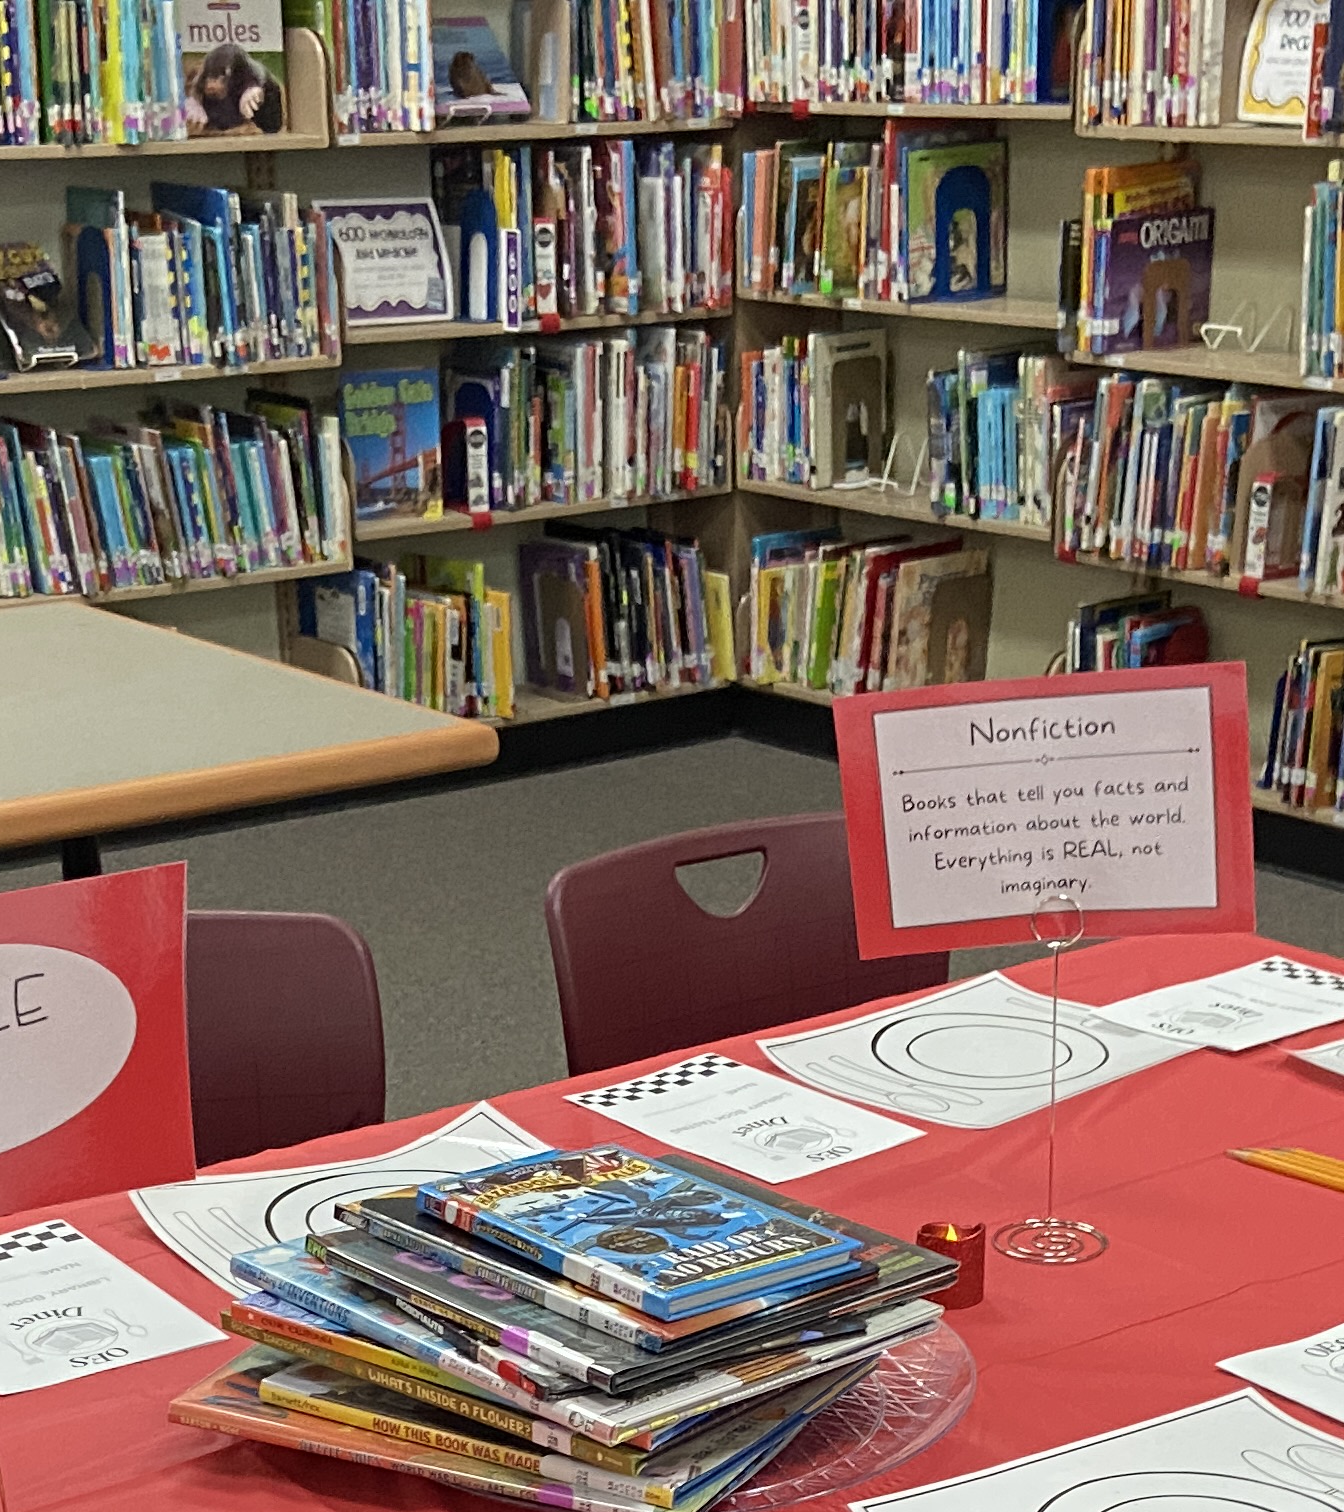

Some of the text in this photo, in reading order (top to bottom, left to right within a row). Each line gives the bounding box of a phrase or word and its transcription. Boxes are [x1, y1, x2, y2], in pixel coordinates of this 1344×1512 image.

[187, 12, 262, 43] moles
[338, 226, 366, 242] 600
[1139, 214, 1210, 249] ORIGAMI
[507, 253, 518, 313] 600
[970, 718, 1116, 746] Nonfiction
[901, 776, 1189, 813] Books that tell you facts and
[908, 807, 1186, 843] information about the world.
[934, 840, 1163, 873] Everything is REAL, not
[1000, 879, 1092, 896] imaginary.
[731, 1116, 788, 1138] Diner
[806, 1145, 854, 1163] OES
[475, 1162, 647, 1206] HAZARDOUS TALES
[658, 1227, 763, 1266] RAID OF
[659, 1233, 811, 1281] NO RETURN
[8, 1305, 85, 1331] Diner
[285, 1282, 353, 1323] INVENTIONS
[68, 1346, 130, 1368] OES
[416, 1384, 457, 1410] INSIDE
[459, 1402, 470, 1415] A
[472, 1405, 532, 1438] FLOWER?
[372, 1417, 540, 1472] HOW THIS BOOK WAS MADE
[391, 1462, 425, 1476] WORLD
